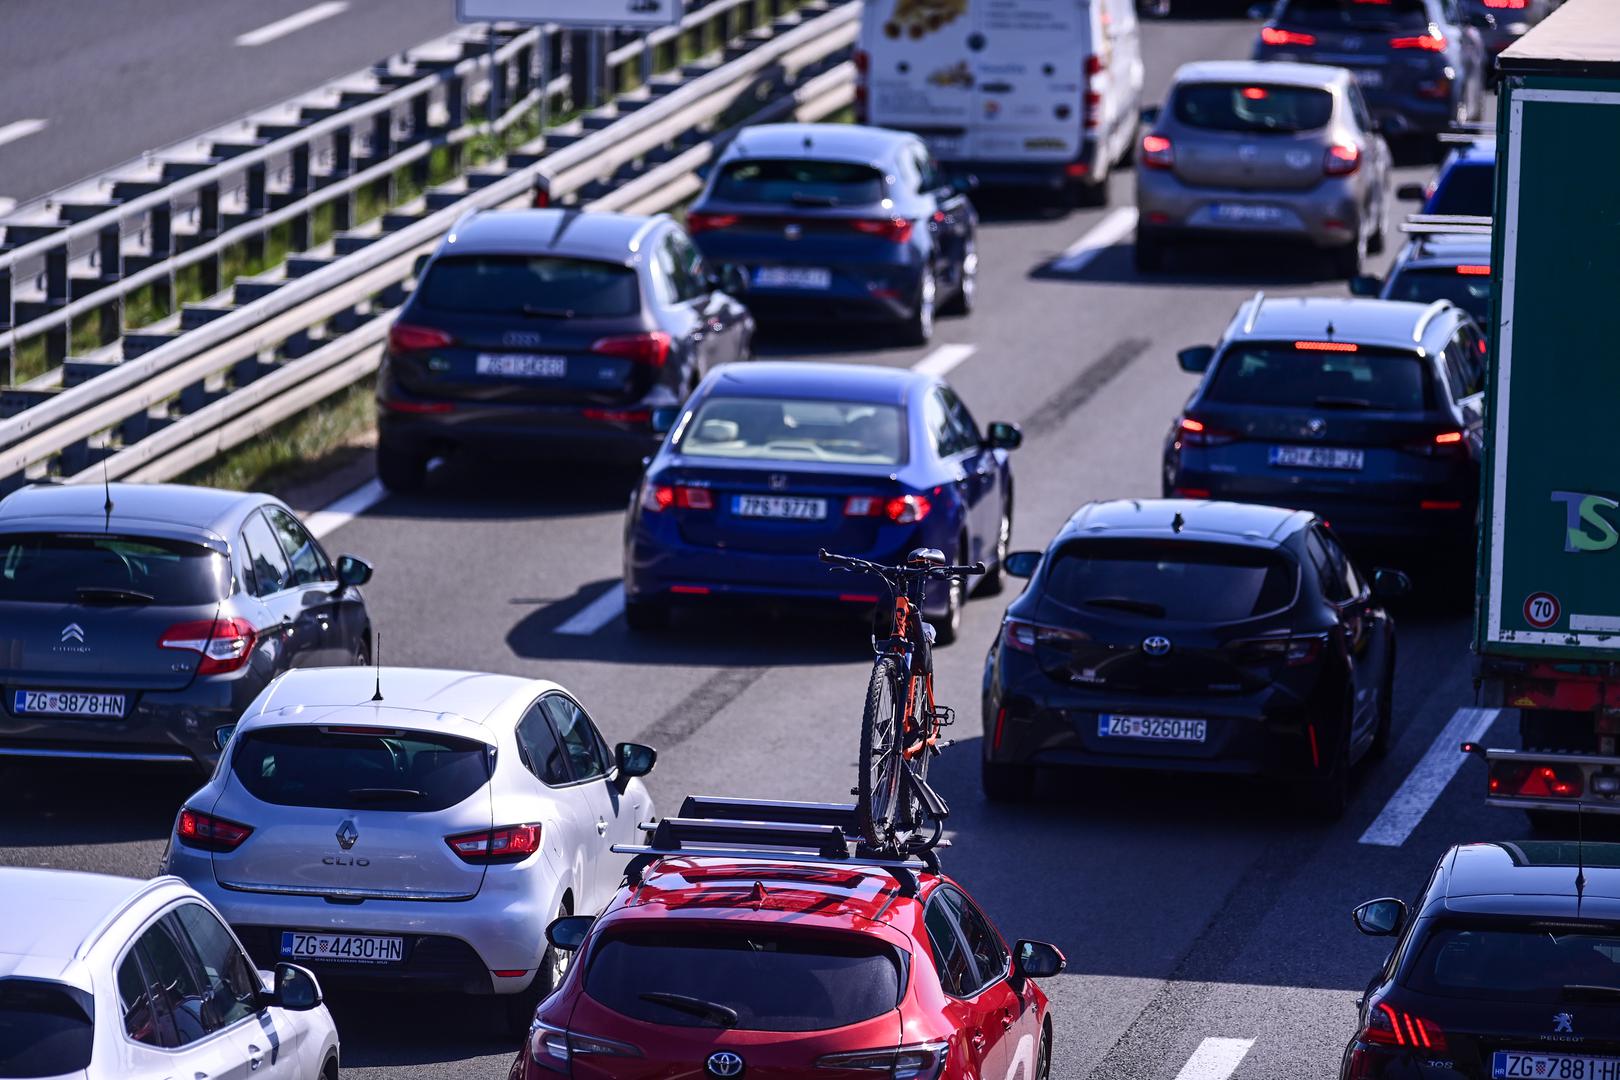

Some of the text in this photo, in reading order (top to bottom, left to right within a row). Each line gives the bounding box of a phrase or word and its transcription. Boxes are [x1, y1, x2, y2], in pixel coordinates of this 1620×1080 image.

[1534, 600, 1552, 618] 70
[27, 693, 48, 711] ZG
[1110, 718, 1131, 735] ZG
[322, 856, 370, 867] CLIO
[294, 935, 317, 955] ZG
[1507, 1055, 1533, 1077] ZG
[1547, 1057, 1620, 1080] 7881-H
